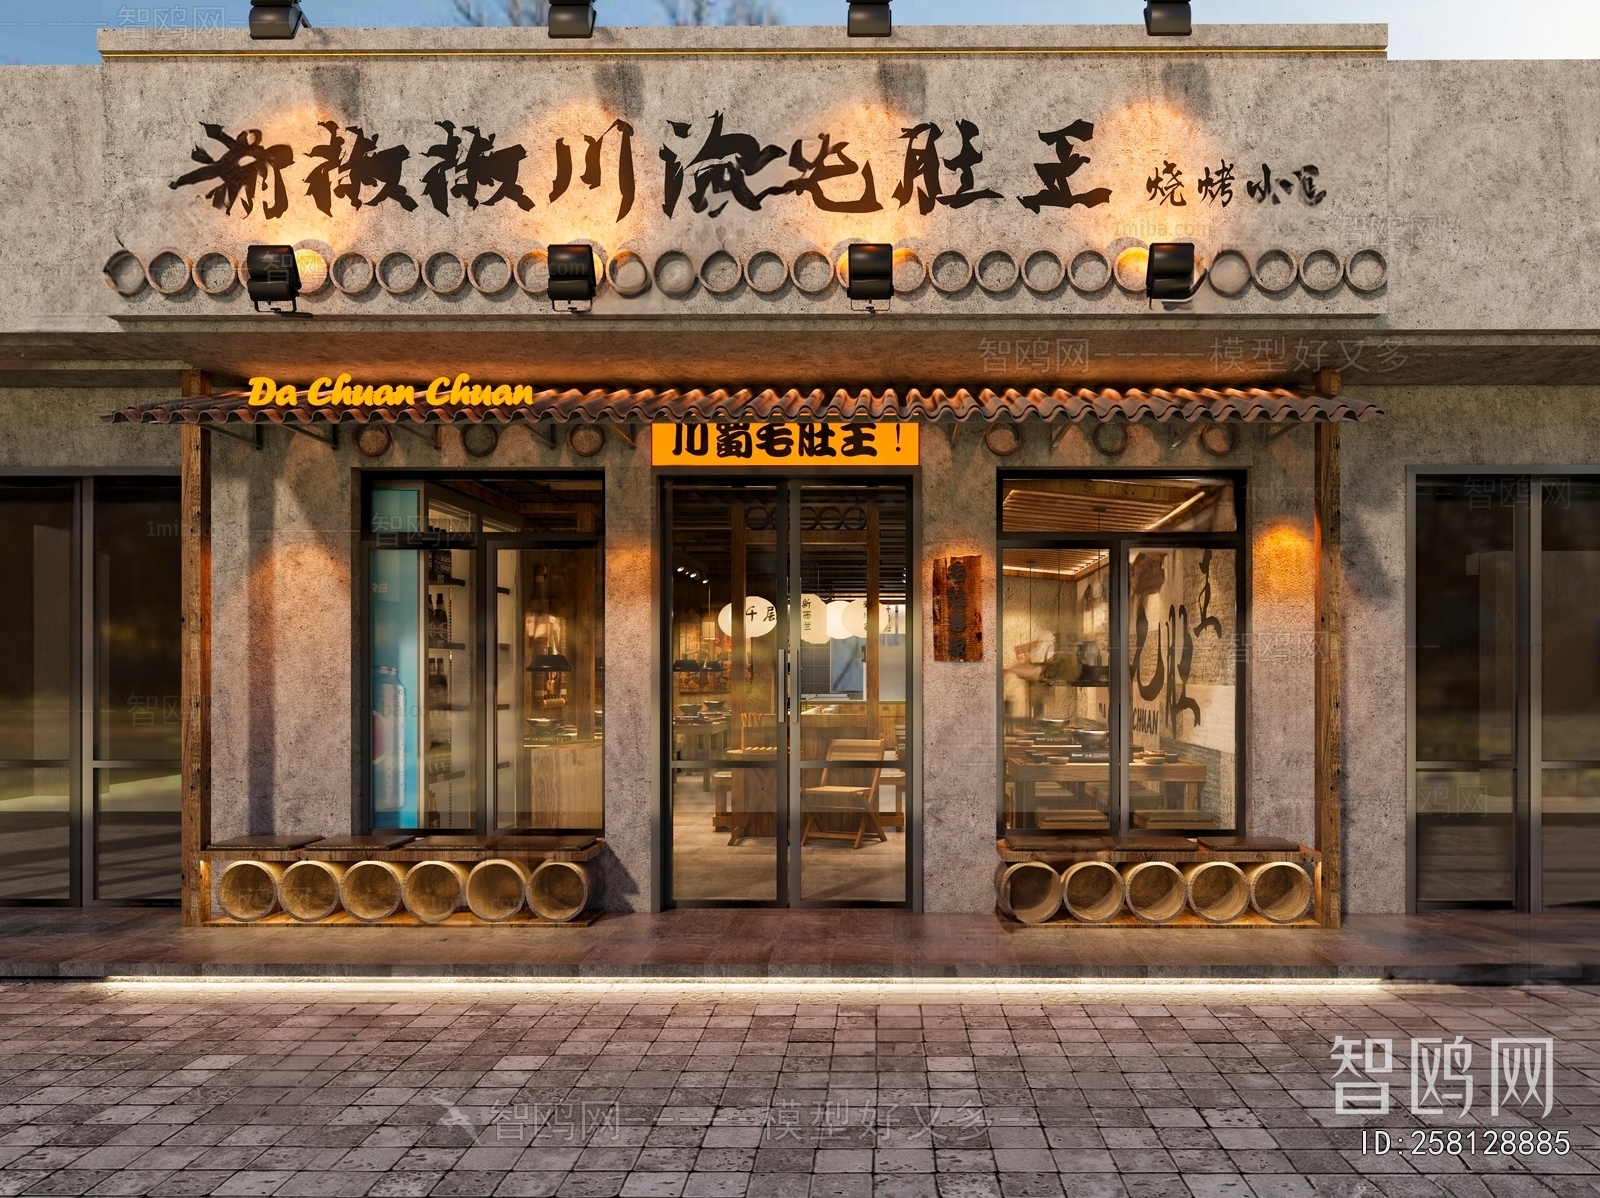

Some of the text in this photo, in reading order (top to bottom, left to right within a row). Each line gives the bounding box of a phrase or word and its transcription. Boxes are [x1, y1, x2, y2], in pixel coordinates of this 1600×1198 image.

[248, 373, 533, 406] Da Chuan Chuan
